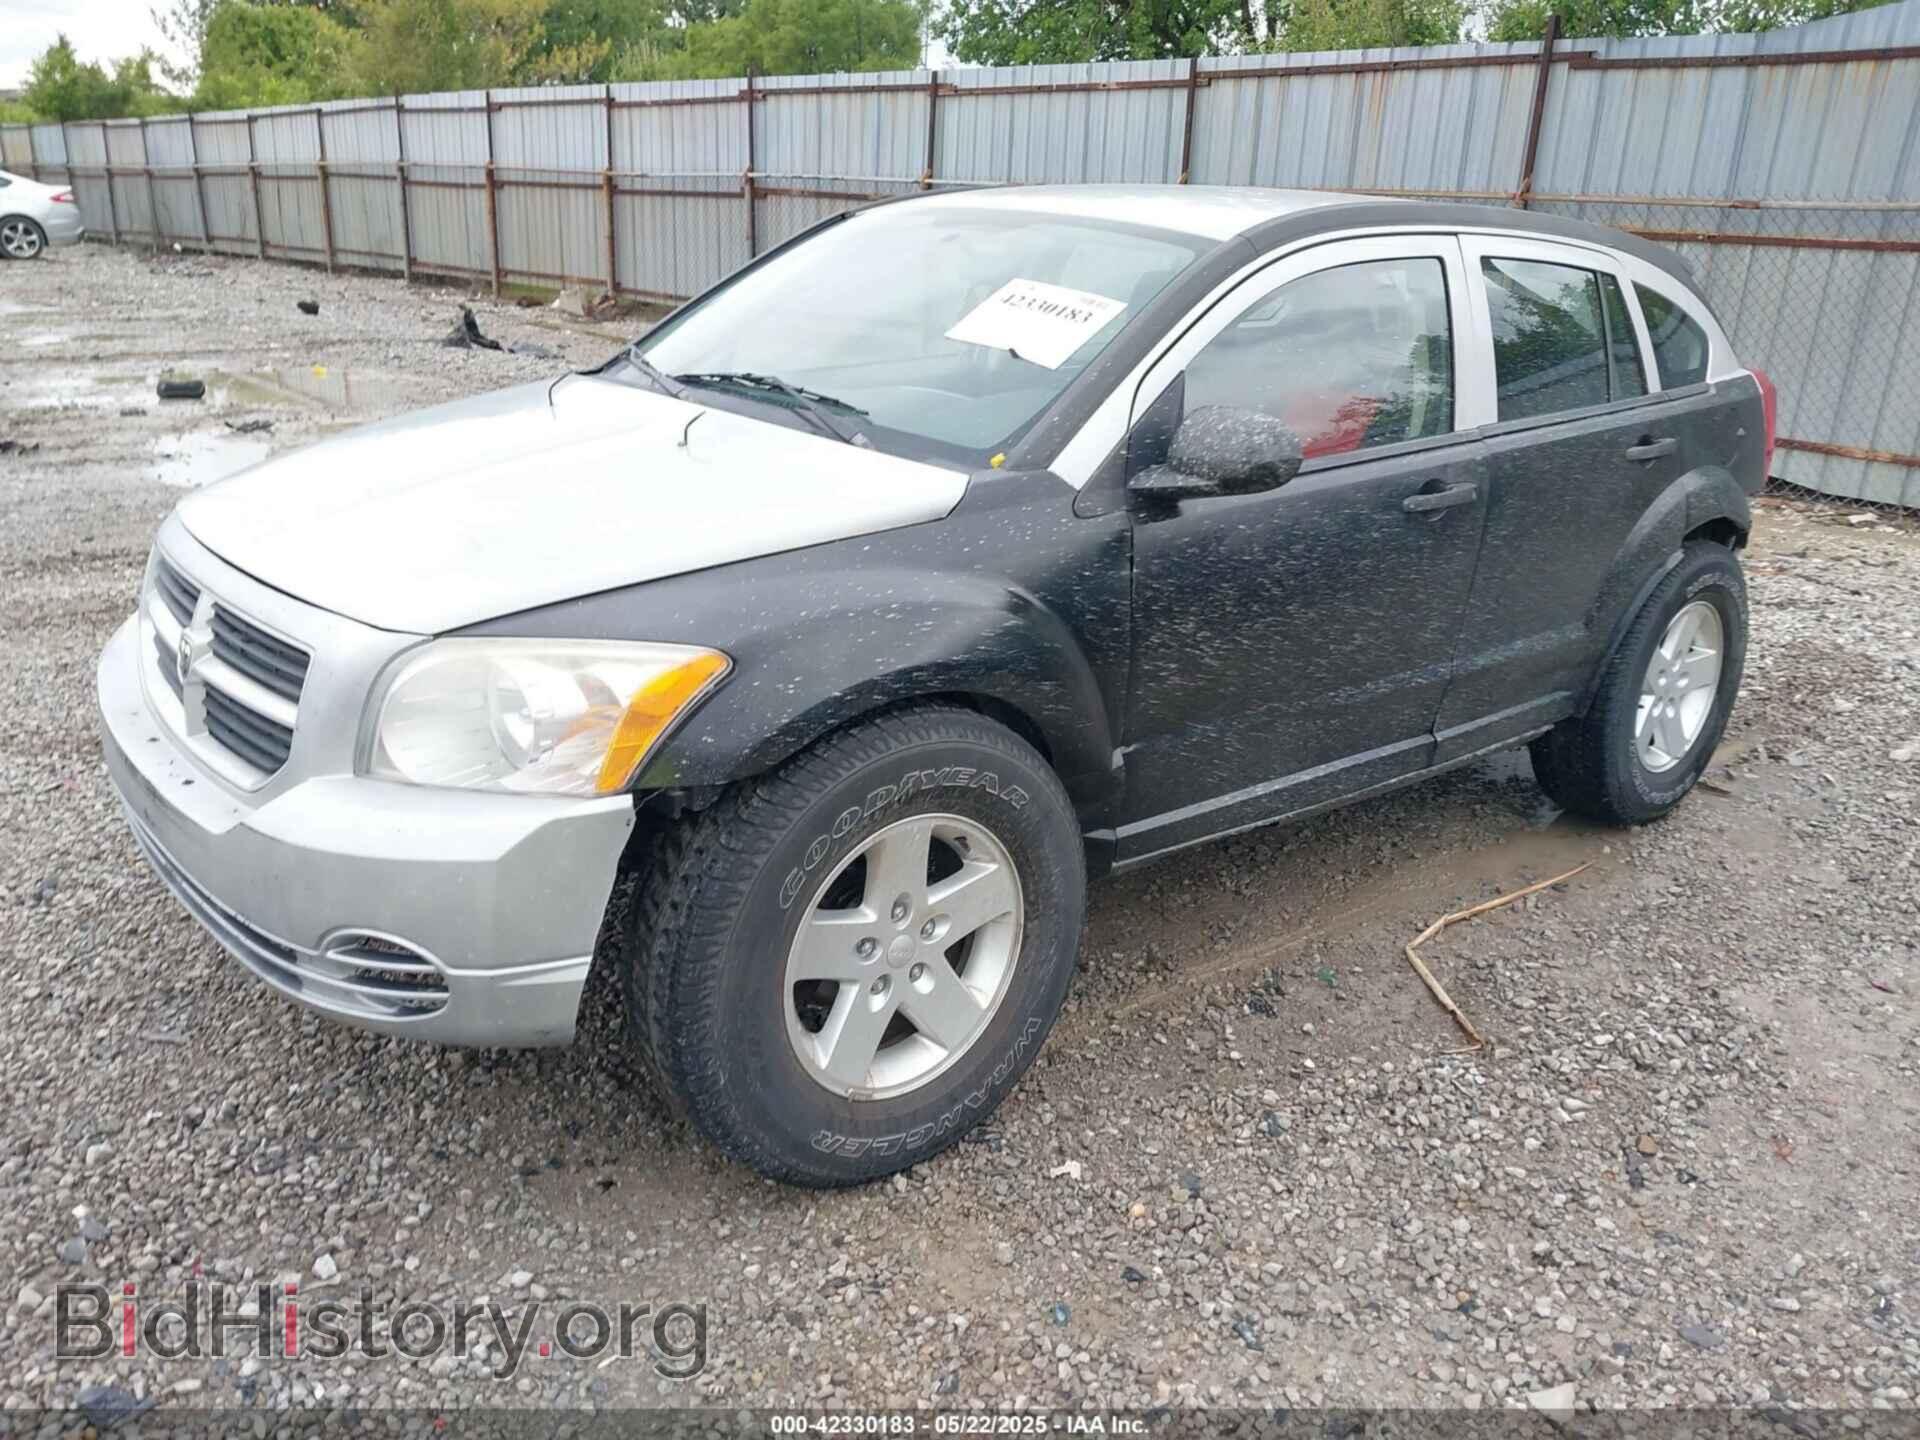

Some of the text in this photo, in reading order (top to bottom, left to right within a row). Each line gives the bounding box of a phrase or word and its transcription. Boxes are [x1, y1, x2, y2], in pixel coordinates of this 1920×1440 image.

[1000, 294, 1093, 324] 42330183
[779, 767, 1030, 910] GOODYEAR
[811, 1017, 1042, 1158] WRANGLER
